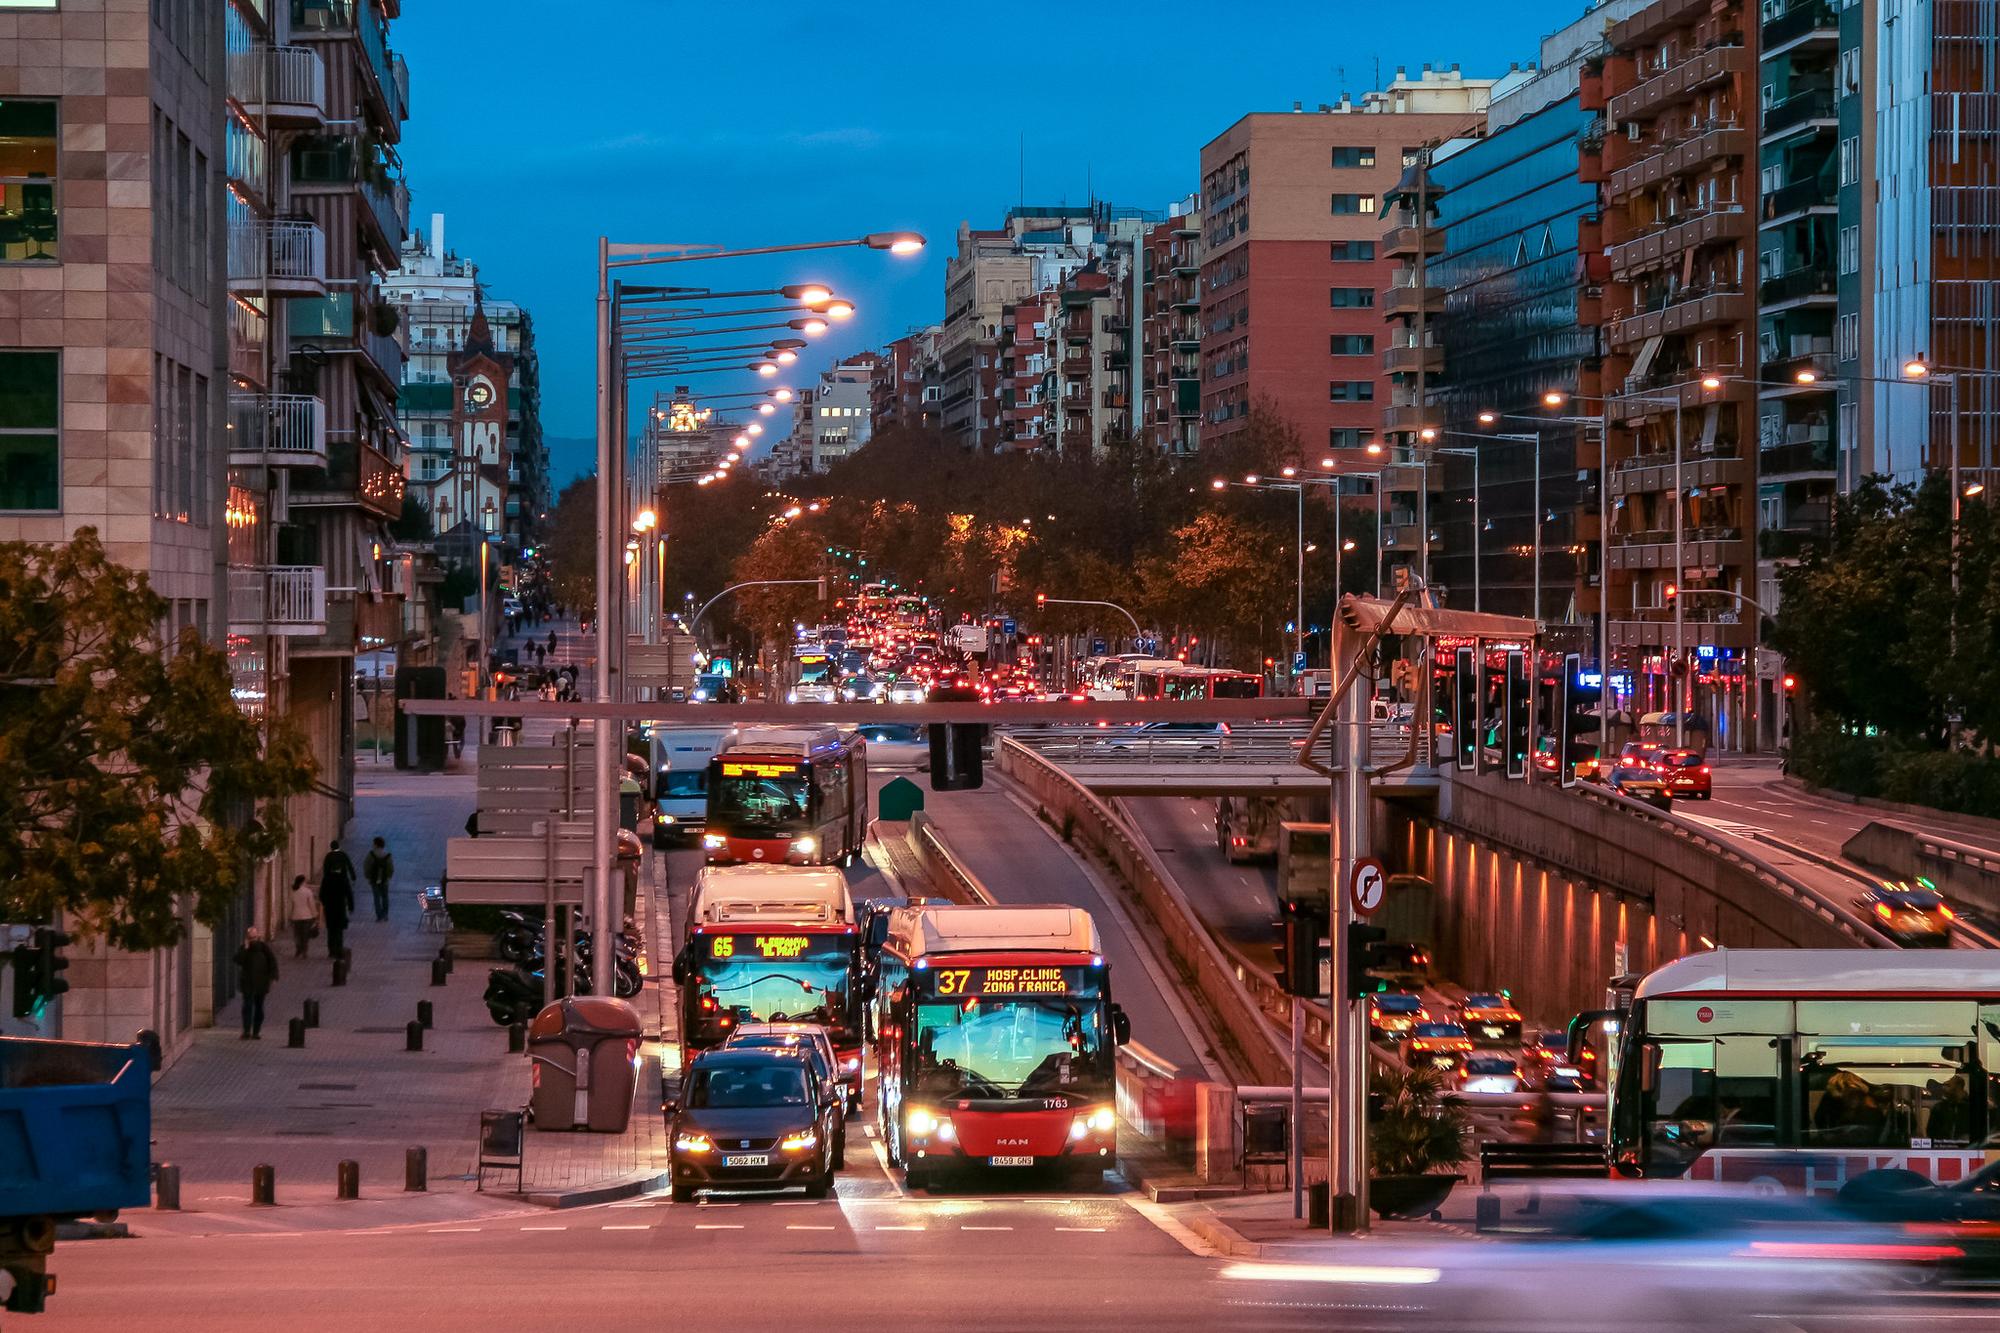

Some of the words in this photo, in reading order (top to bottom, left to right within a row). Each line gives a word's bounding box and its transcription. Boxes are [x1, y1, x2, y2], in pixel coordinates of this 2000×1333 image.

[1295, 653, 1304, 664] P
[713, 936, 734, 957] 65
[939, 970, 971, 994] 37
[987, 968, 1062, 981] HOSP.CLINIC
[983, 981, 1015, 993] ZONA
[1018, 980, 1066, 993] FRANCA
[1043, 1099, 1068, 1109] 1763
[996, 1138, 1029, 1146] MAN
